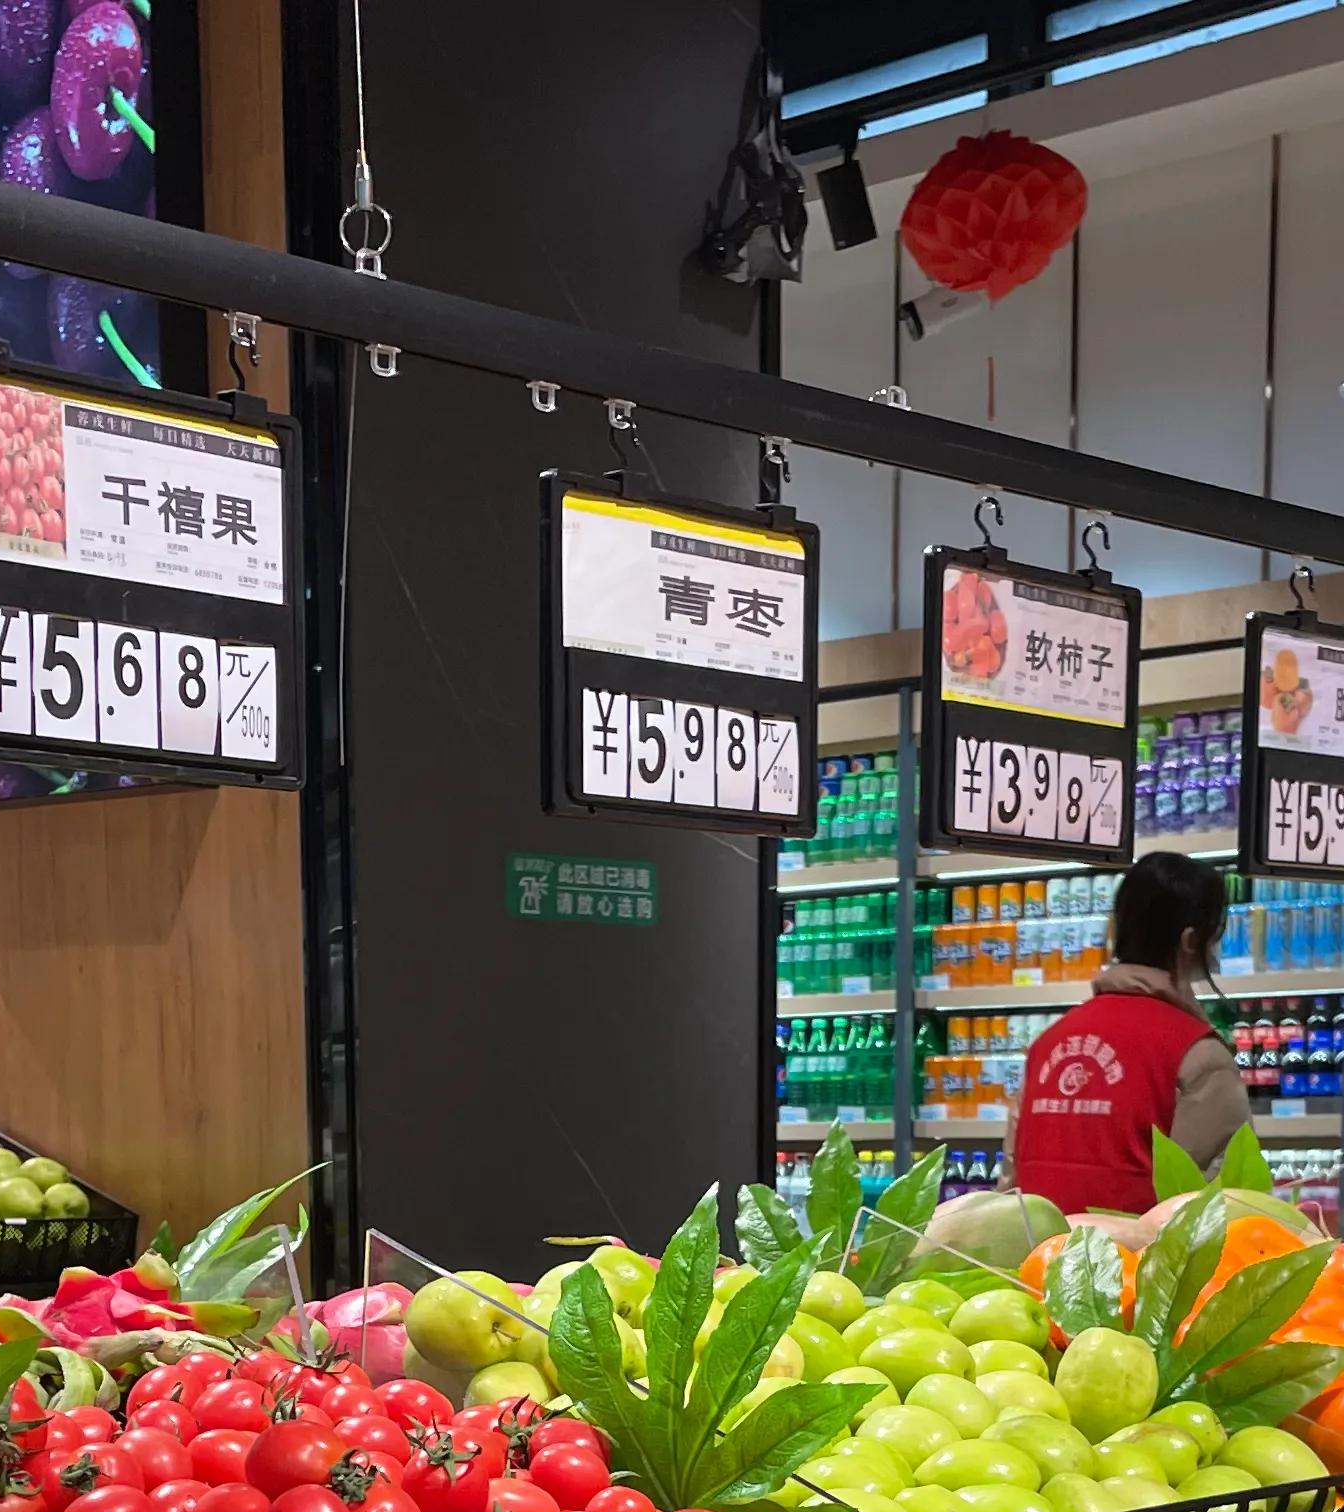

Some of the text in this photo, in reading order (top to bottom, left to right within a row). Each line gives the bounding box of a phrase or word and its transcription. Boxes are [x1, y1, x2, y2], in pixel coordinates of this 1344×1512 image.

[659, 575, 785, 638] 青枣
[1025, 629, 1113, 683] 软柿子
